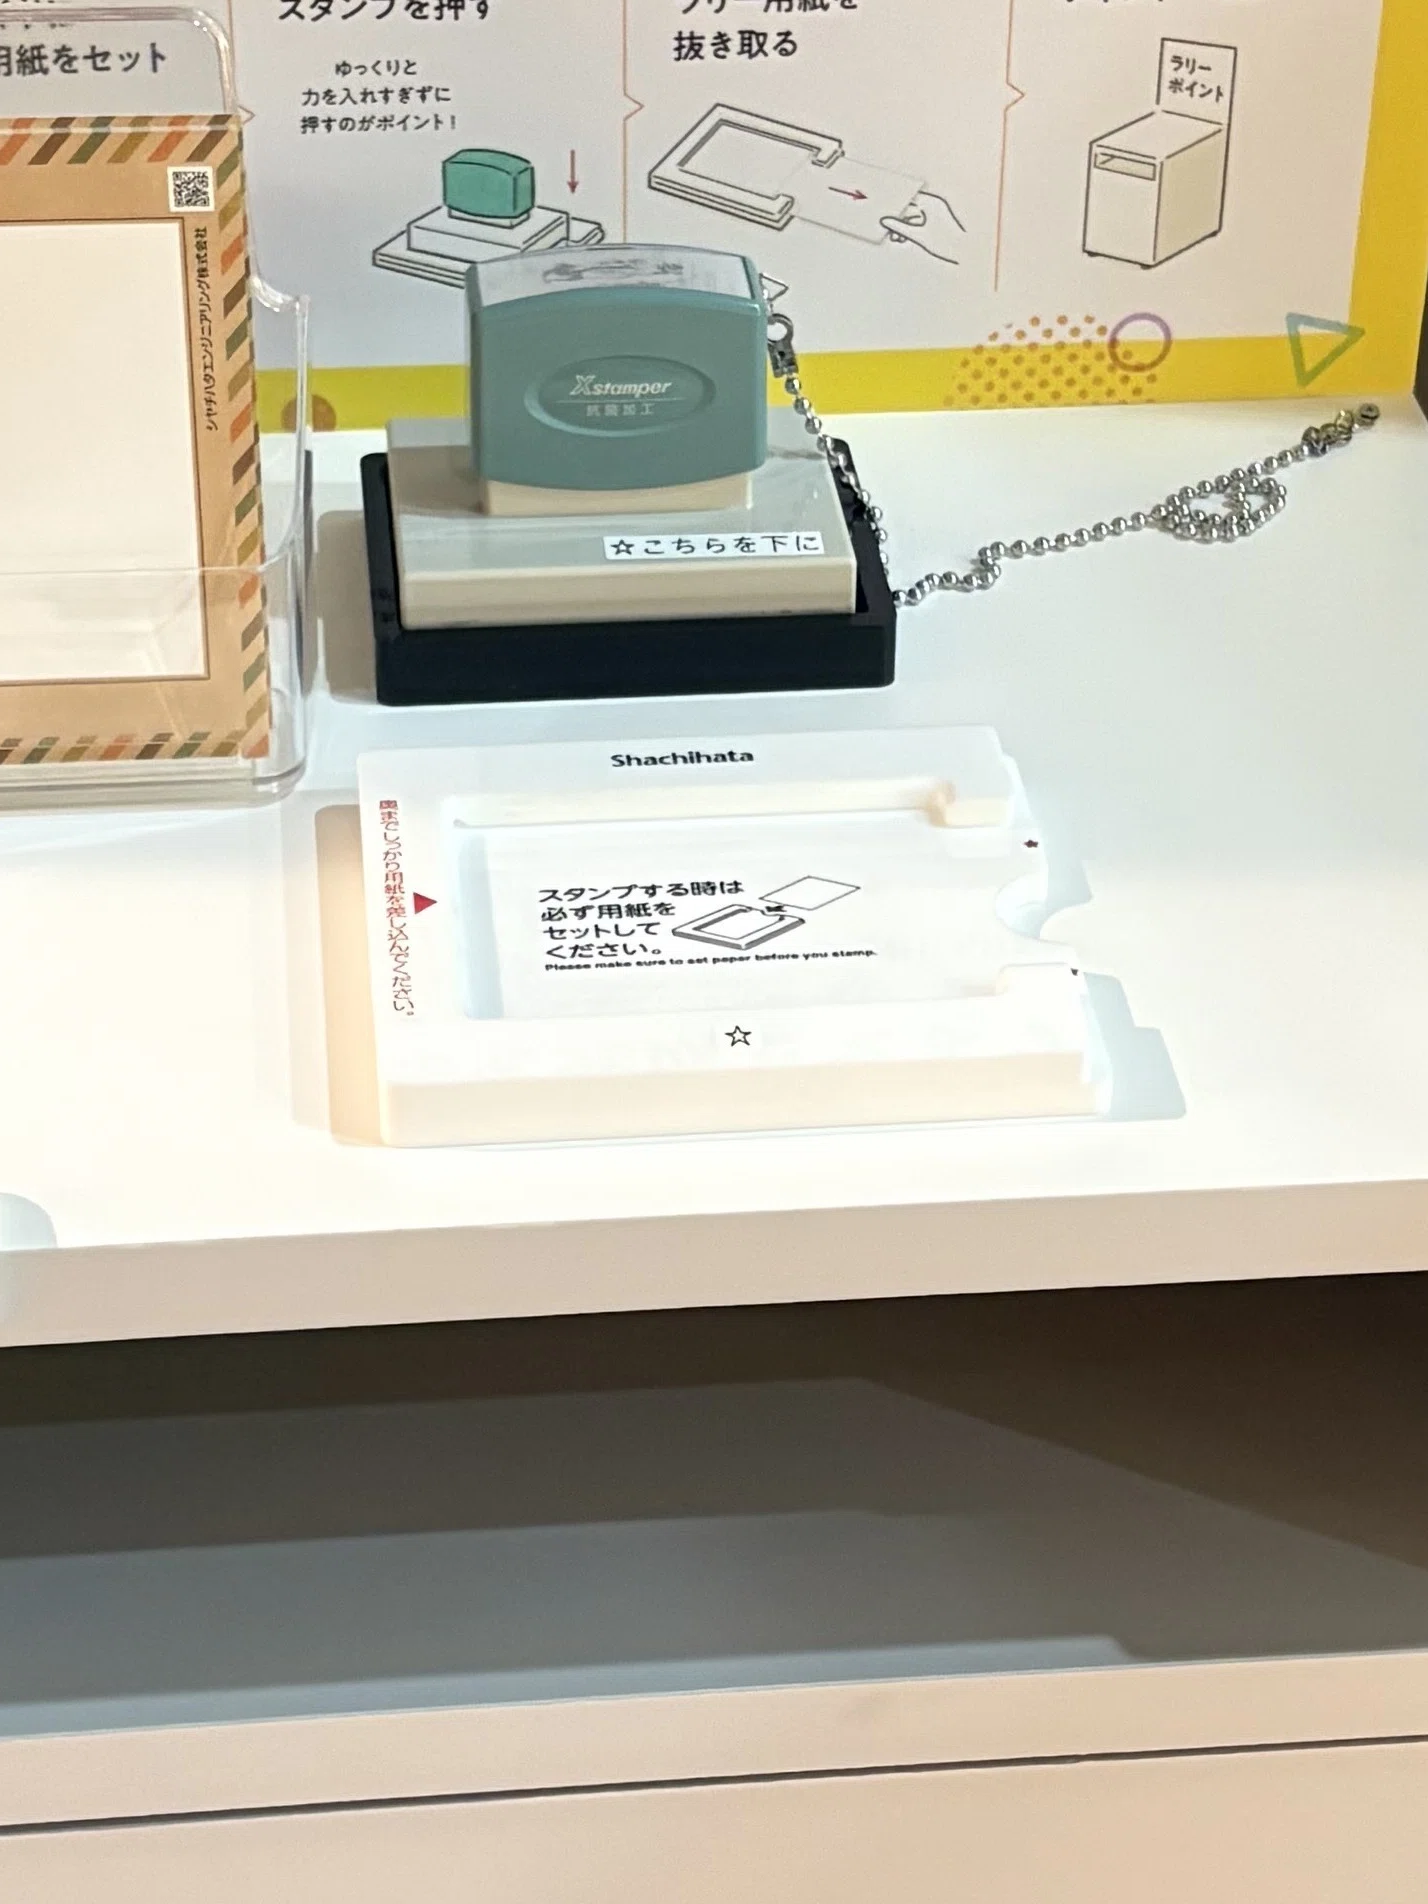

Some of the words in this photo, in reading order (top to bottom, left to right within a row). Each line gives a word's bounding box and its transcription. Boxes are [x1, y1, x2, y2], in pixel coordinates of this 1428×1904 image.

[672, 28, 799, 63] 抜き取る
[335, 59, 418, 77] ゆっくりと
[1169, 54, 1213, 75] ラリー
[301, 86, 452, 107] 力を入れすぎずに
[1167, 76, 1224, 104] ポイント
[569, 374, 674, 399] Xstamper
[609, 749, 755, 769] Shachihata
[538, 879, 745, 904] スタンプする時は
[541, 902, 676, 923] 必ず用紙を
[543, 922, 661, 940] セットして
[544, 963, 592, 971] Please
[595, 961, 632, 969] make
[636, 959, 666, 967] sure
[712, 955, 751, 964] paper
[755, 953, 799, 961] before
[802, 952, 829, 960] you
[545, 942, 663, 960] ください。
